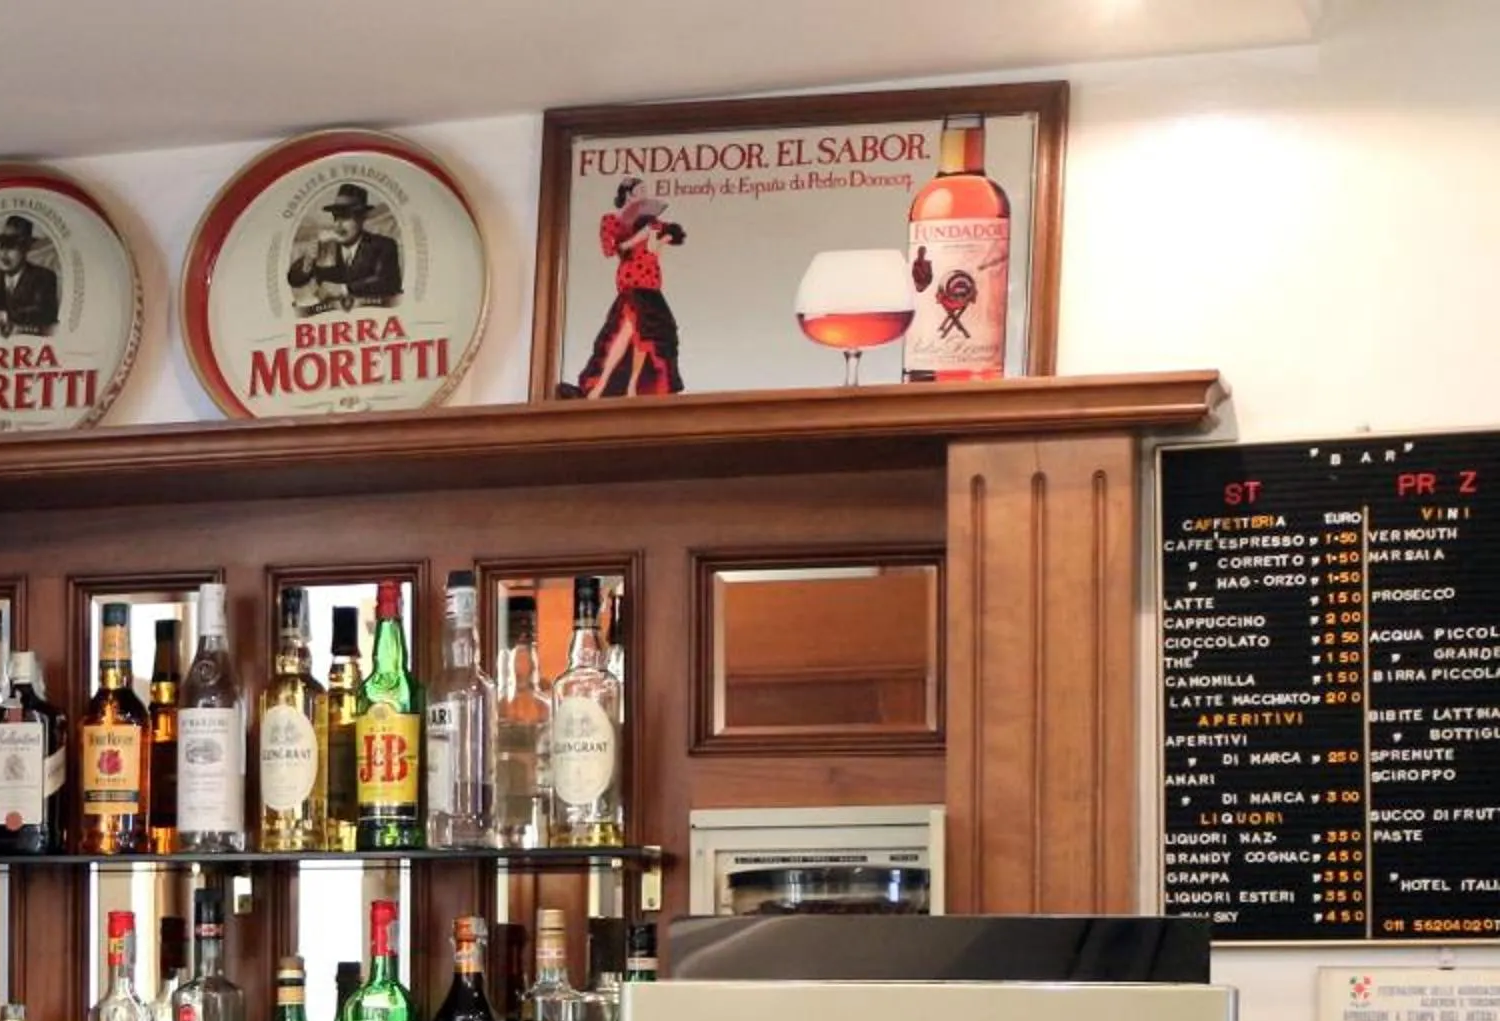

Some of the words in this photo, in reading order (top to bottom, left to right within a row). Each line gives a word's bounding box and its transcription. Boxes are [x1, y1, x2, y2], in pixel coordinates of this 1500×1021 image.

[578, 142, 770, 177] FUNDADOR.
[777, 139, 812, 167] EL
[816, 132, 931, 164] SABOR.
[654, 179, 671, 197] El
[674, 178, 716, 201] brandy
[719, 178, 736, 194] de
[738, 177, 786, 199] España
[807, 172, 847, 189] Pedro
[294, 315, 406, 349] BIRRA
[248, 338, 450, 401] MORETTI
[1224, 481, 1262, 505] ST
[1324, 512, 1362, 525] EURO
[1421, 507, 1470, 521] VINI
[1182, 515, 1287, 531] CAFFETTERIA
[1219, 535, 1305, 550] ESPRESSO
[1368, 527, 1458, 543] VERMOUTH
[1217, 554, 1305, 570] CORRETTO
[1371, 587, 1455, 603] PROSECCO
[1163, 597, 1215, 611] LATTE
[1163, 615, 1266, 630] CAPPUCCINO
[1164, 635, 1270, 650] CIOCCOLATO
[1369, 629, 1424, 643] ACQUA
[1433, 645, 1500, 660] GRANDE
[1165, 674, 1256, 689] CAMOMILLA
[1372, 669, 1427, 683] BIRRA
[1169, 694, 1224, 709] LATTE
[1232, 692, 1311, 706] MACCHIATO
[1197, 711, 1304, 727] APERITIVI
[1367, 708, 1423, 722] BIBITE
[1433, 707, 1500, 721] LATTINA
[1165, 733, 1248, 747] APERITIVI
[1222, 753, 1239, 766] DI
[1250, 751, 1302, 765] MARCA
[1370, 748, 1455, 763] SPREMUTE
[1165, 774, 1216, 786] AMARI
[1371, 768, 1456, 783] SCIROPPO
[1221, 792, 1238, 805] DI
[1250, 791, 1305, 804] MARCA
[1200, 811, 1284, 825] LIQUORI
[1369, 809, 1425, 822] SUCCO
[1433, 808, 1449, 821] DI
[1453, 807, 1500, 821] FRUT
[1164, 832, 1227, 846] LIQUORI
[1373, 829, 1423, 843] PASTE
[1165, 852, 1231, 865] BRANDY
[1244, 850, 1311, 864] COGNAC
[1166, 871, 1230, 884] GRAPPA
[1400, 878, 1451, 892] HOTEL
[1461, 878, 1500, 892] ITALI
[1165, 890, 1231, 904] LIQUORI
[1239, 889, 1296, 903] ESTERI
